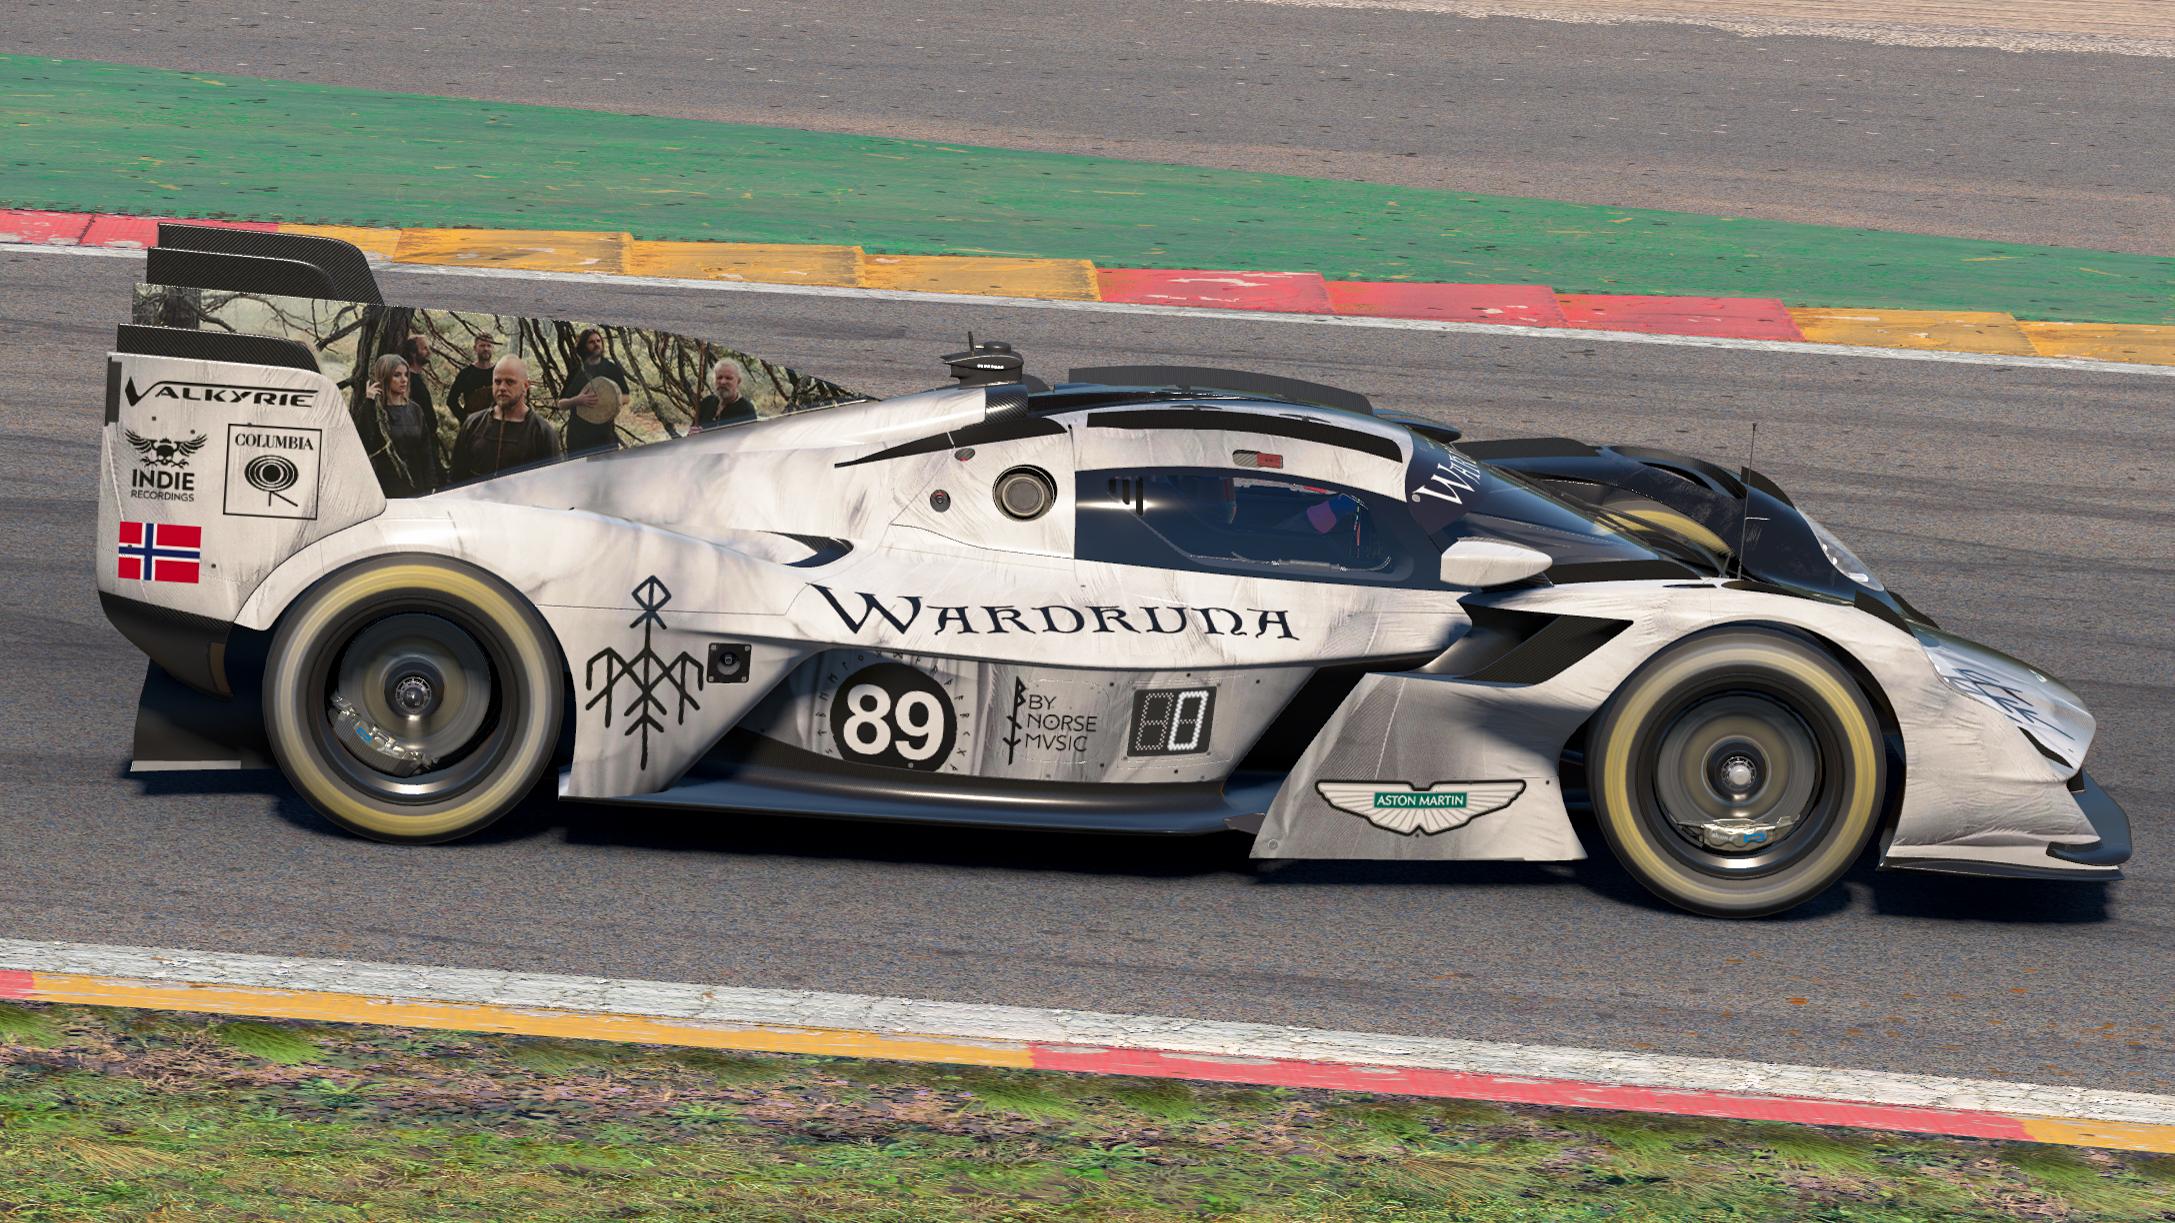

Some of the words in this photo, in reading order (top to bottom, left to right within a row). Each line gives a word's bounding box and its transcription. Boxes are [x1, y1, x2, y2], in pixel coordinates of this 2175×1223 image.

[124, 377, 319, 408] VALKYRIE
[234, 433, 314, 451] COLUMBIA
[131, 469, 195, 491] INDIE
[130, 489, 195, 502] RECORDINGS
[806, 582, 1300, 641] WARDRUNA
[1028, 694, 1057, 710] BY
[843, 683, 945, 761] 89
[1027, 713, 1098, 732] NORSE
[1377, 794, 1417, 807] ASTON
[1419, 794, 1465, 807] MARTIN
